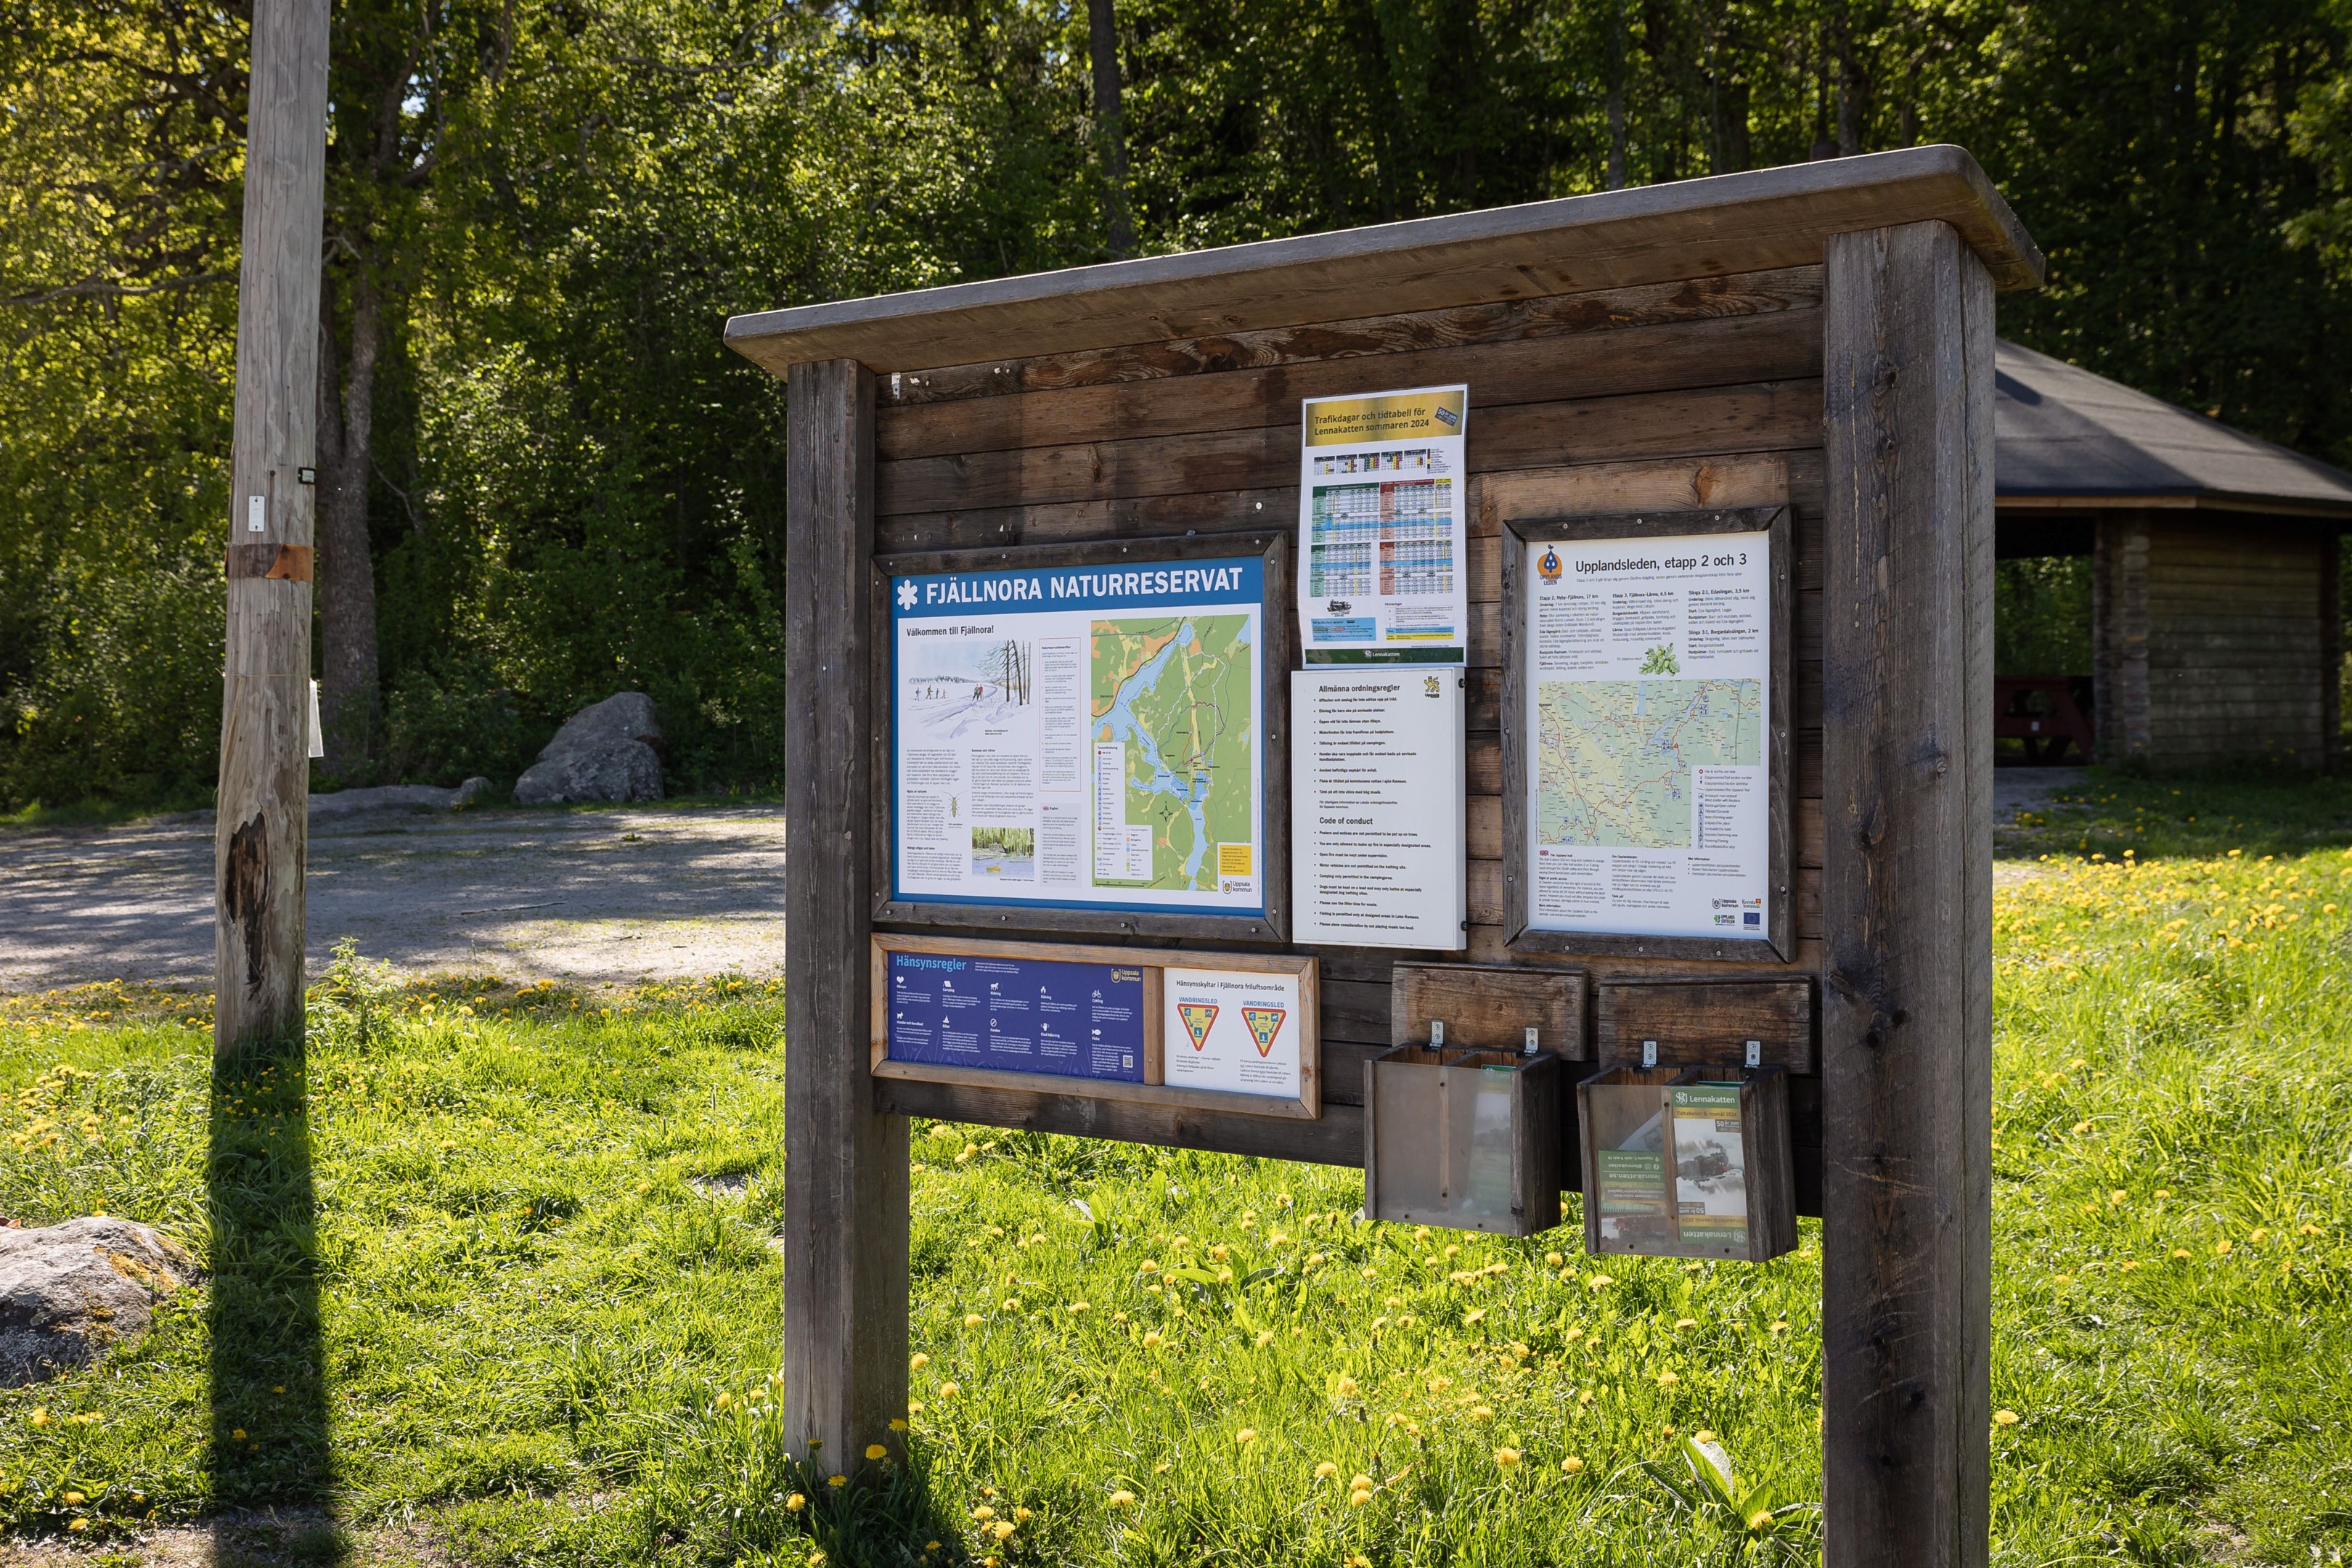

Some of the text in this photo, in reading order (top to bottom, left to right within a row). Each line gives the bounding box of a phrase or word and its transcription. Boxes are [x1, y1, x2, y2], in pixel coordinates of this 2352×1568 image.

[1315, 407, 1426, 425] Trafikdagar och tidtabell för
[1315, 419, 1429, 436] Lennakatten sommaren 2024
[1576, 553, 1747, 574] Upplandsleden, etapp 2 och 3
[927, 567, 1243, 604] FJÄLLNORA NATURRESERVAT
[960, 625, 994, 636] Fjällnora!
[1352, 684, 1400, 693] ordningsregler
[897, 955, 967, 972] Hänsynsregler
[1176, 980, 1216, 989] Hänsynsskyltar
